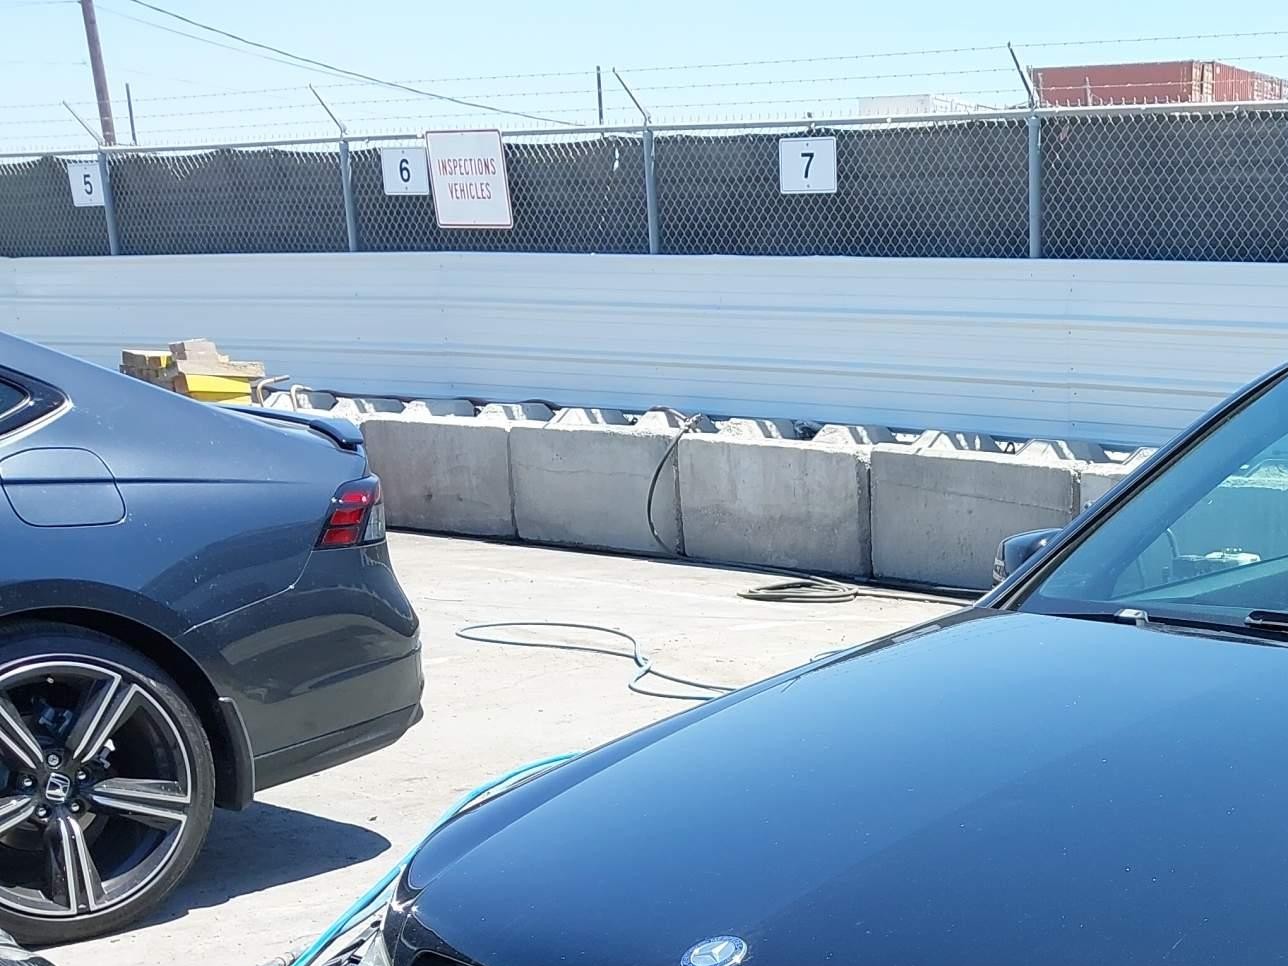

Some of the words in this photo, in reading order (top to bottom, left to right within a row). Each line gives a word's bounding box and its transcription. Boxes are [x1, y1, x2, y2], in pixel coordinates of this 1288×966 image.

[399, 158, 411, 183] 6
[437, 158, 497, 177] INSPECTIONS
[801, 152, 815, 179] 7
[83, 173, 93, 195] 5
[447, 182, 492, 200] VEHICLES
